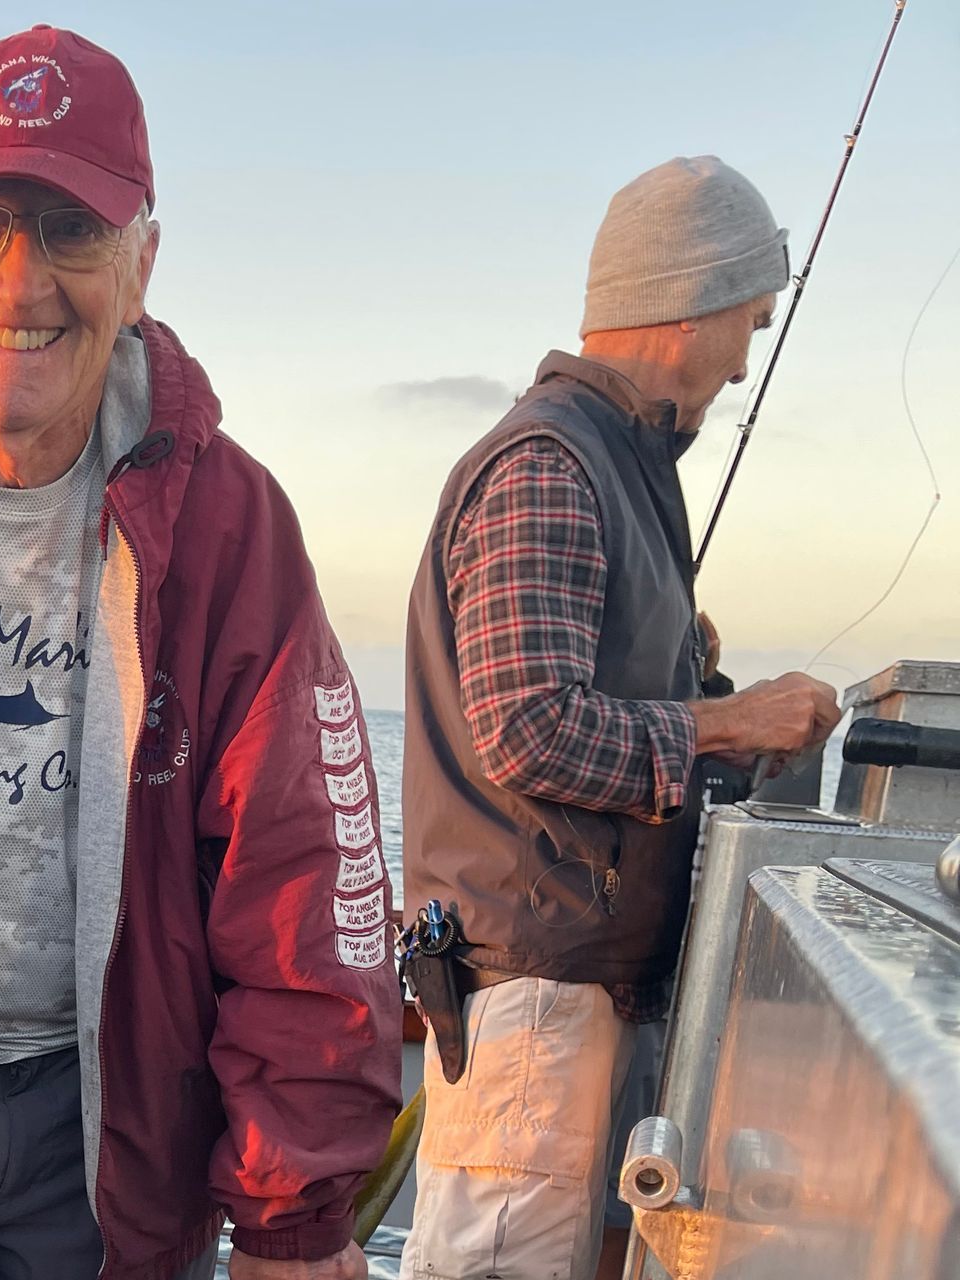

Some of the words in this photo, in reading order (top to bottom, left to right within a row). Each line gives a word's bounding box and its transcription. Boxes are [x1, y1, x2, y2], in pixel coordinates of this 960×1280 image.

[18, 118, 52, 128] REEL
[53, 96, 72, 120] CLUB
[148, 769, 176, 786] REEL
[334, 780, 344, 790] TOP
[347, 772, 364, 789] ANGLER
[338, 792, 351, 802] MAY
[342, 818, 352, 828] TOP
[354, 811, 369, 830] ANGLER
[346, 832, 358, 842] MAY
[344, 862, 354, 874] TOP
[356, 855, 376, 874] ANGLER
[342, 878, 358, 888] JULY
[339, 902, 354, 912] TOP
[356, 896, 381, 914] ANGLER
[346, 914, 362, 925] AUG.
[344, 940, 360, 952] TOP
[363, 934, 384, 952] ANGLER
